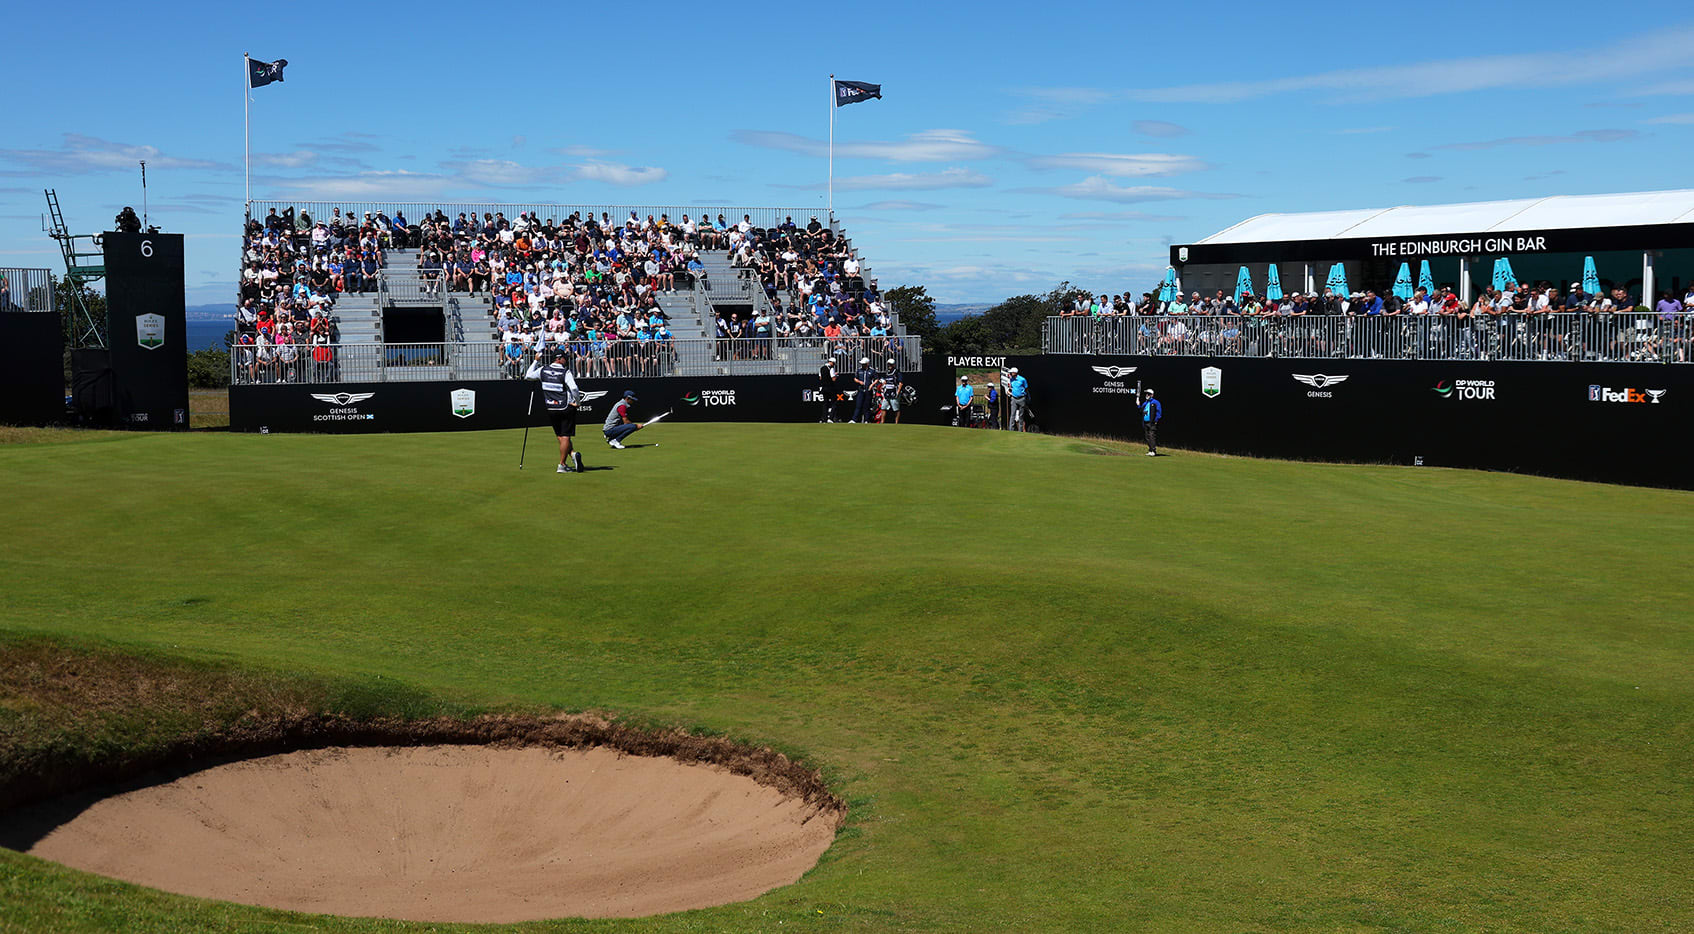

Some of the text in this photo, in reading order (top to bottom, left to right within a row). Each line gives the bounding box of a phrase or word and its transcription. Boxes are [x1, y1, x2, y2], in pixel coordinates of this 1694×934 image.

[141, 239, 153, 257] 6
[1371, 236, 1547, 256] THE EDINBURGH GIN BAR
[947, 356, 1007, 368] PLAYER EXIT
[812, 390, 845, 402] Fex
[1306, 390, 1333, 398] GENESIS
[1455, 386, 1496, 400] TOUR
[1602, 387, 1646, 403] FedEx
[702, 395, 737, 407] TOUR
[329, 407, 358, 415] GENESIS
[347, 413, 366, 421] OPEN
